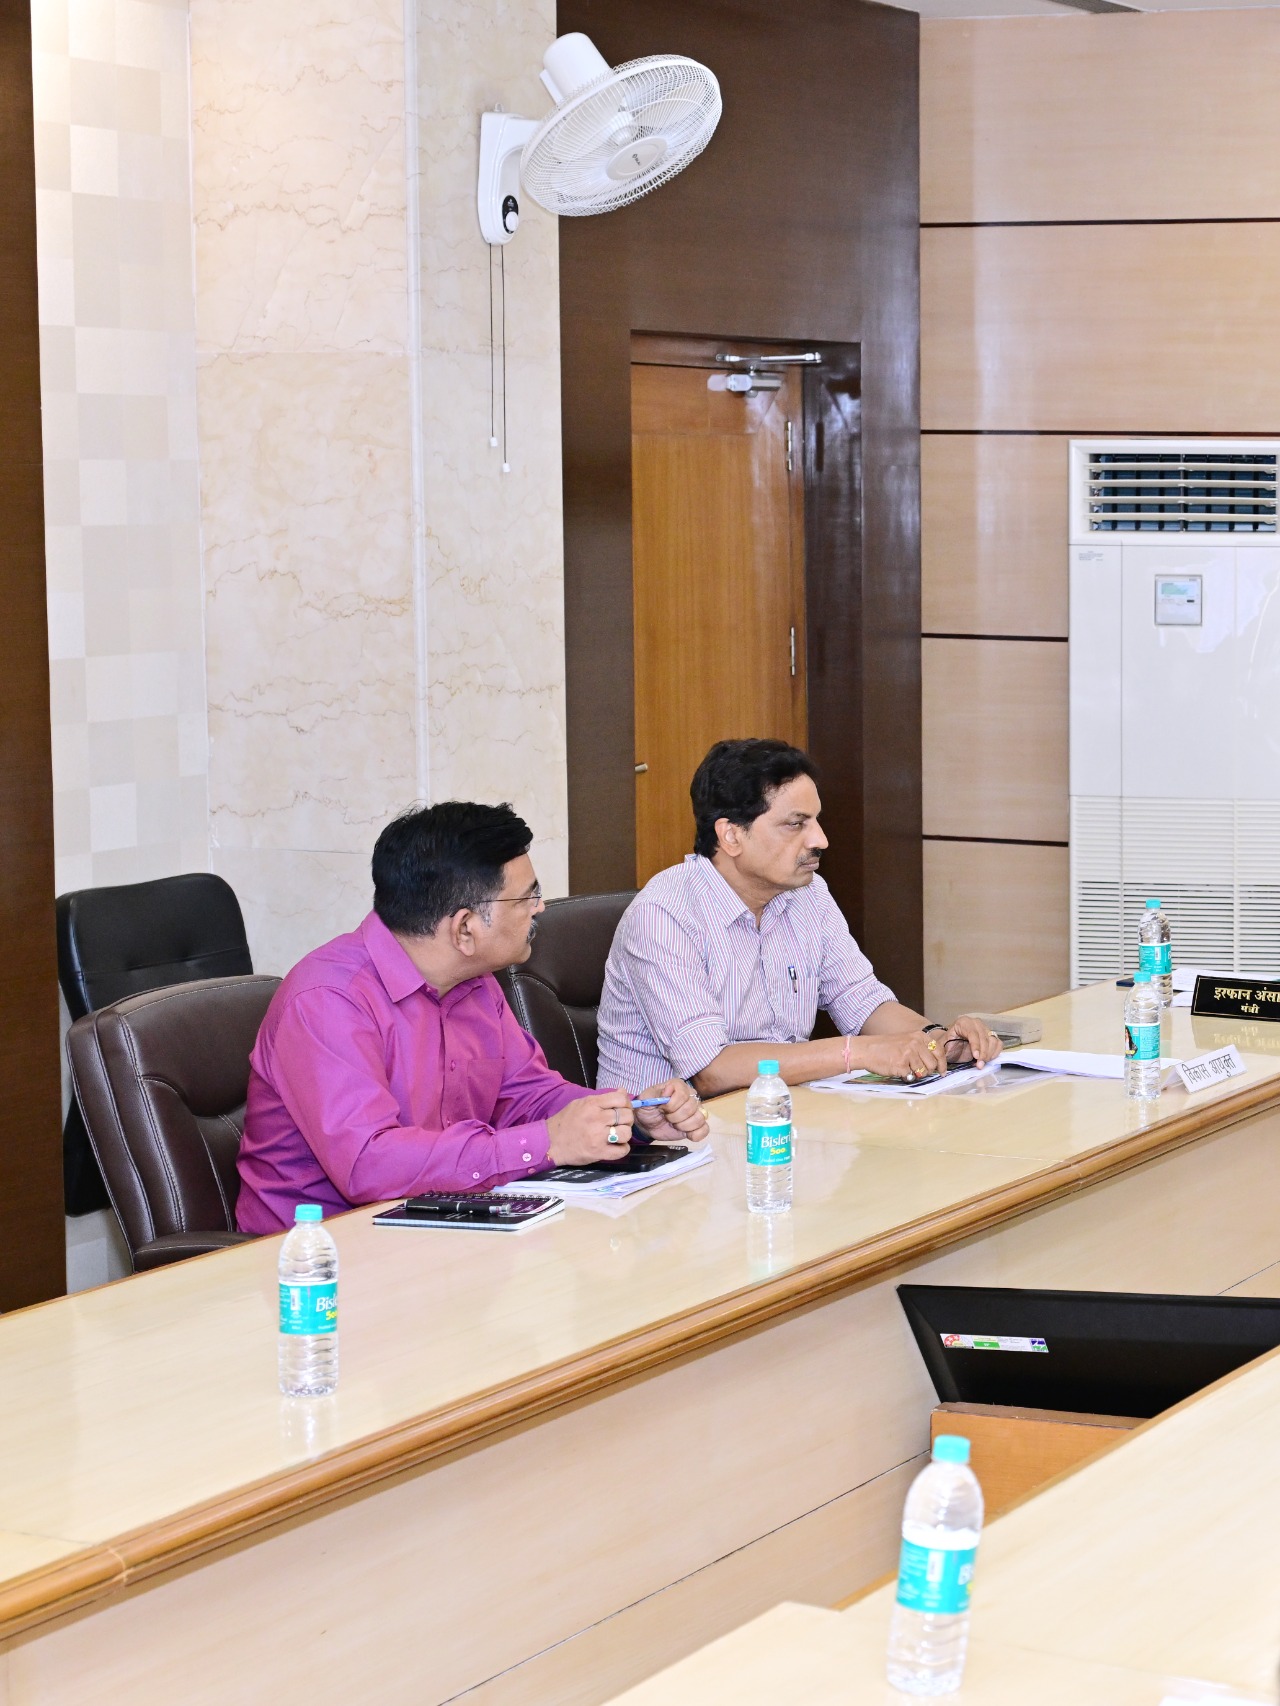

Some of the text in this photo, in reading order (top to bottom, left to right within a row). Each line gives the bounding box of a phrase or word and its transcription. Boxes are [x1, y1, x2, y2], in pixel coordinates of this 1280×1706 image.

[1213, 987, 1253, 1001] इरफान
[1240, 1003, 1260, 1014] मंत्री
[1181, 1063, 1212, 1085] विकास
[761, 1131, 792, 1149] Bisleri
